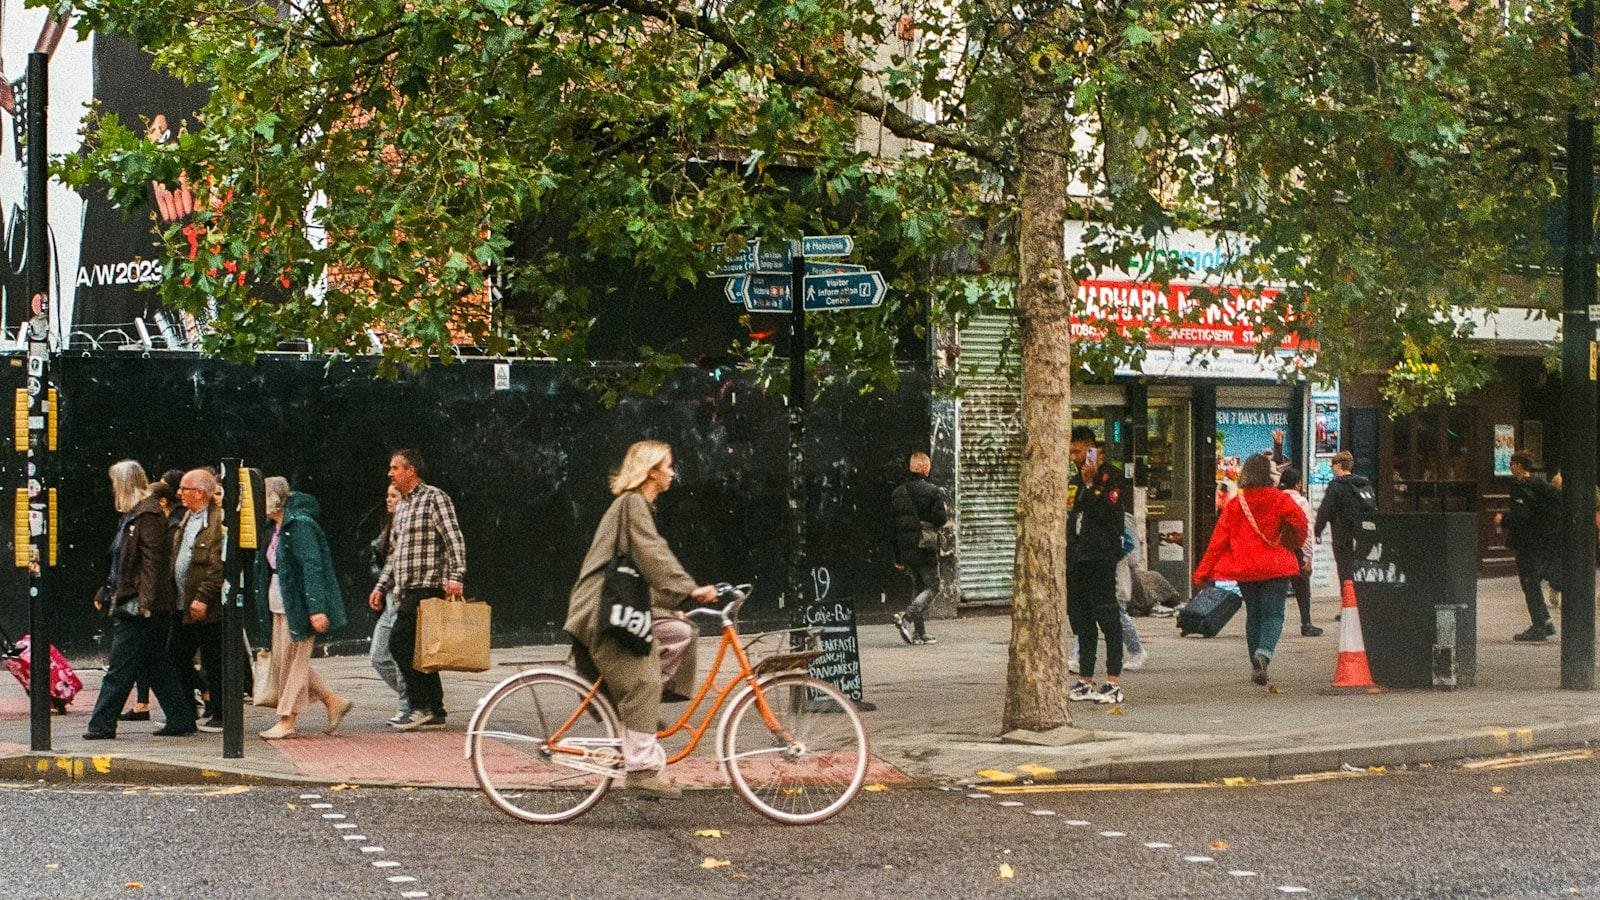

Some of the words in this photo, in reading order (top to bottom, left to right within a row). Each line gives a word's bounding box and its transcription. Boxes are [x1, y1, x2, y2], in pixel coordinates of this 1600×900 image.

[826, 279, 849, 287] Visitor
[818, 288, 858, 297] Information
[1230, 412, 1236, 424] 7
[1238, 411, 1258, 424] DAYS
[1259, 412, 1266, 424] A
[1267, 412, 1288, 425] WEEK
[810, 566, 830, 601] 19
